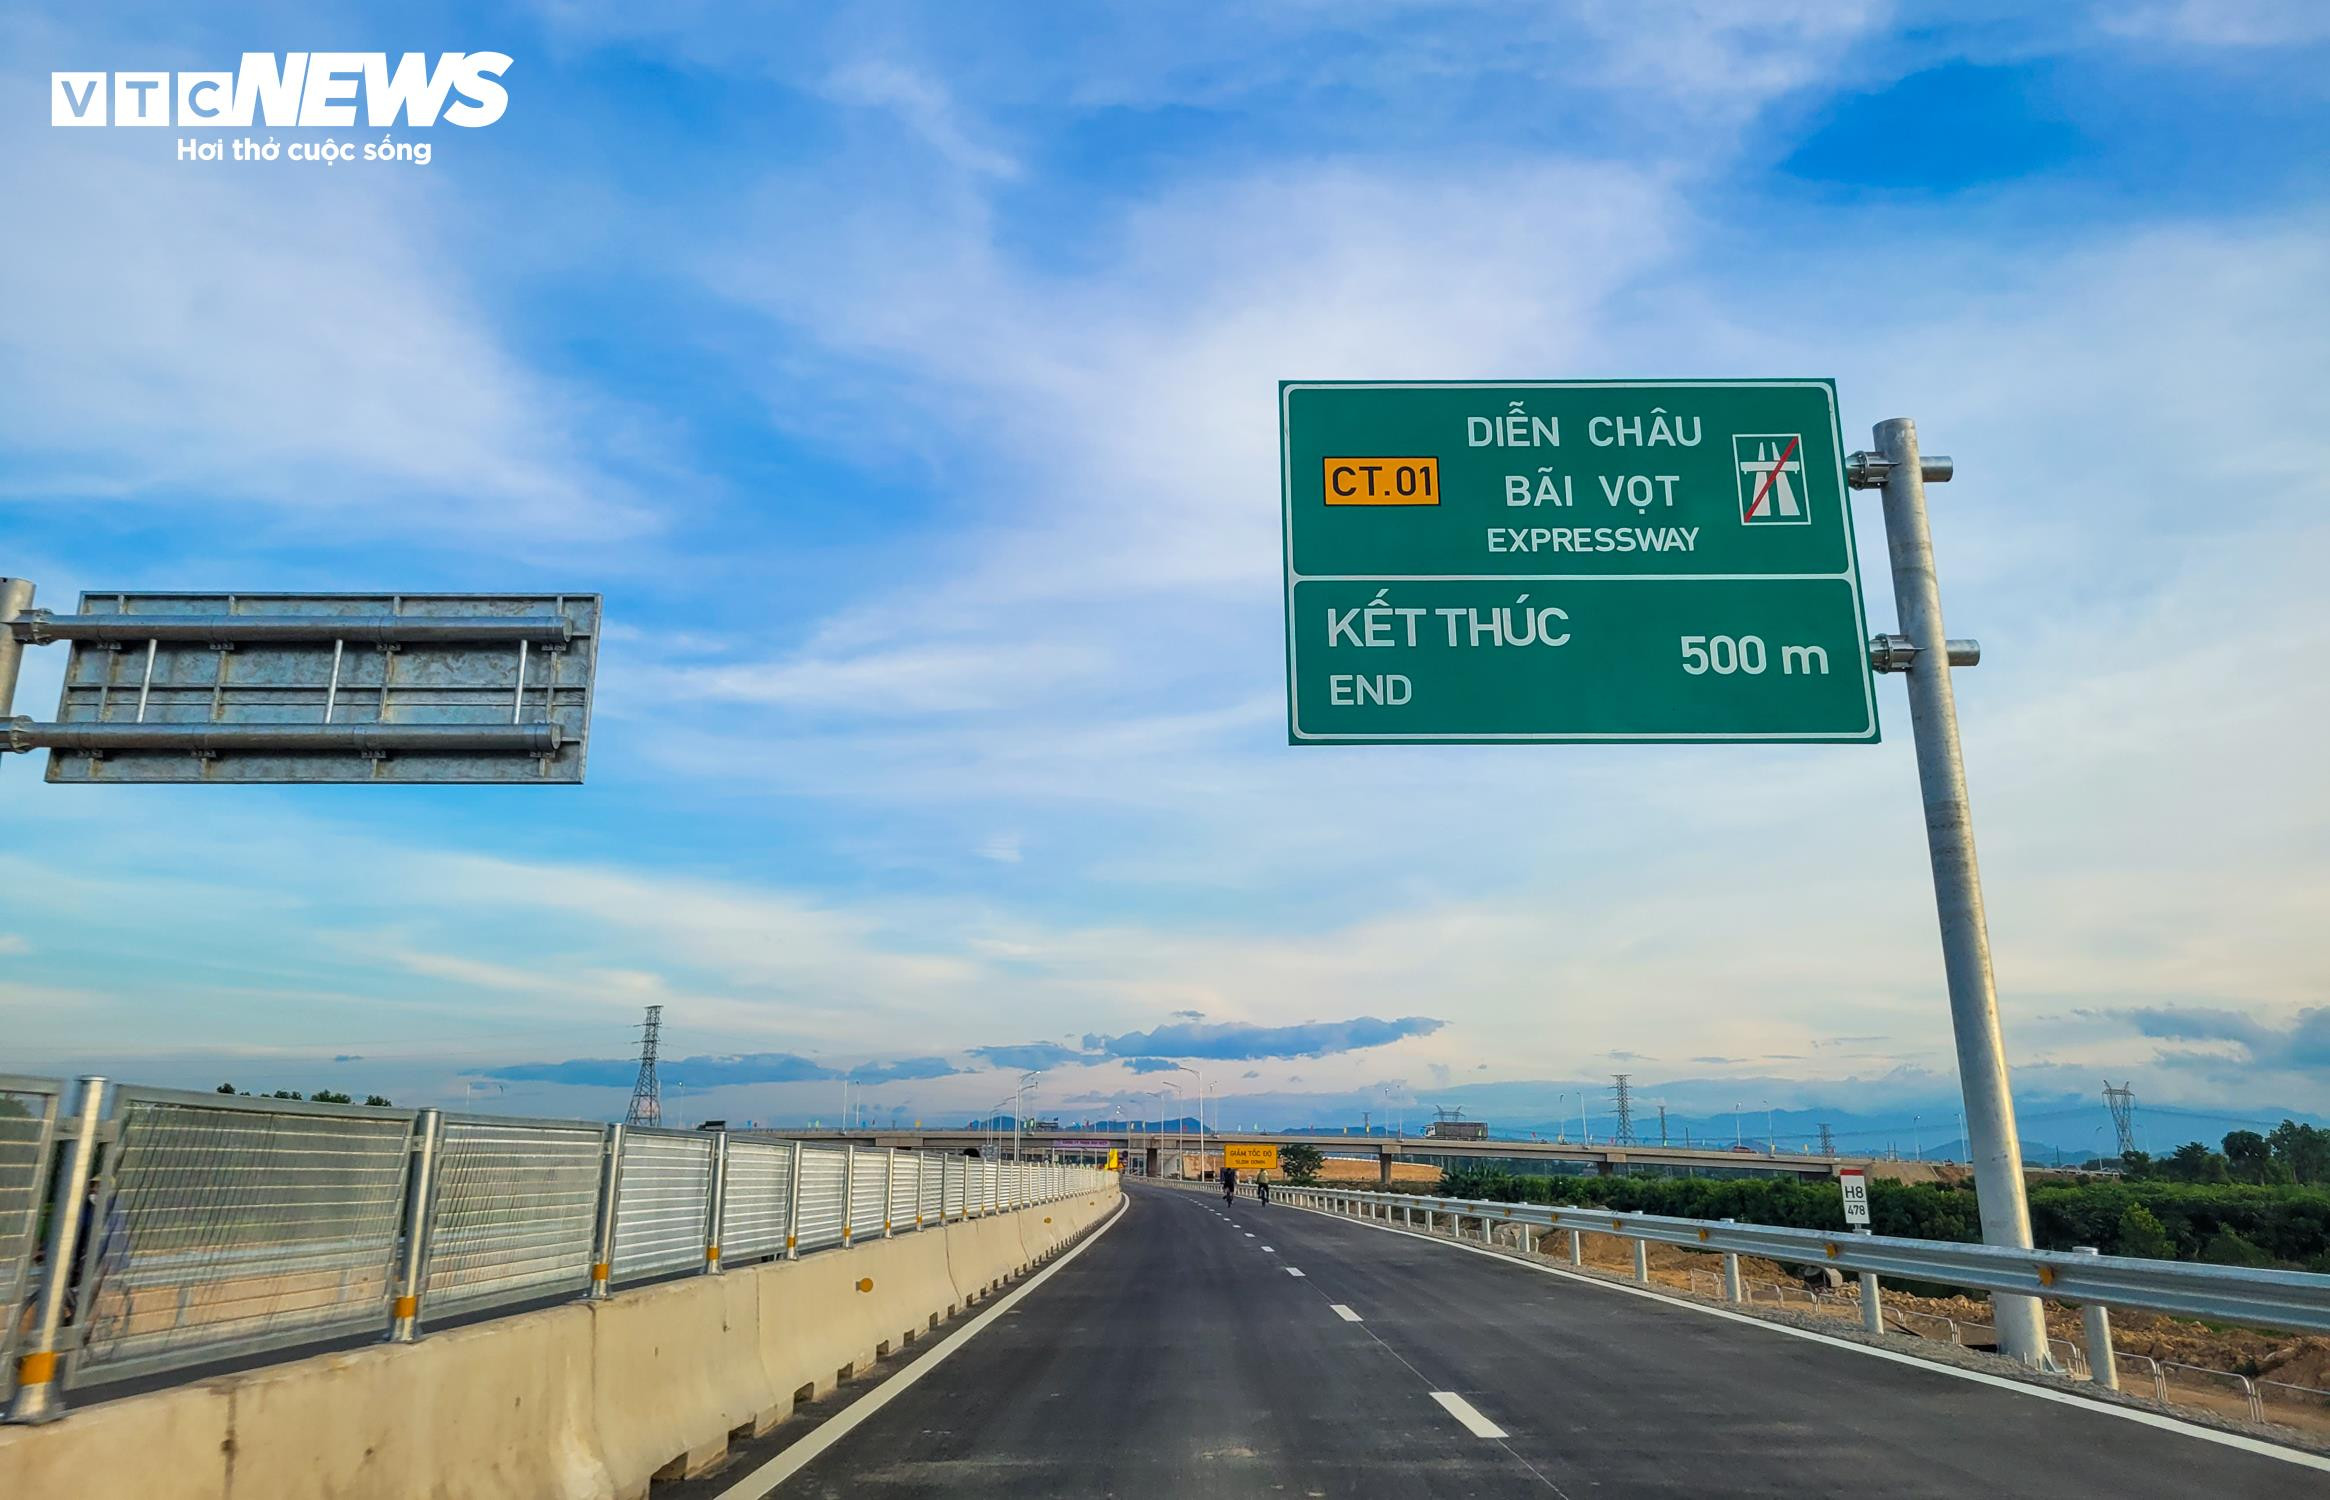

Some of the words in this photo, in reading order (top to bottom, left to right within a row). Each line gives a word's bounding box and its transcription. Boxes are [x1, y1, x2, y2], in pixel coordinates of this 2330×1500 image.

[1467, 401, 1560, 447] DIỄN
[1588, 407, 1702, 447] CHÂU
[1331, 465, 1432, 497] CT.01
[1505, 466, 1573, 507] BÃI
[1598, 475, 1680, 515] VỌT
[1487, 527, 1700, 552] EXPRESSWAY
[1327, 588, 1426, 647] KẾT
[1435, 594, 1571, 647] THÚC
[1680, 635, 1767, 675] 500
[1781, 645, 1829, 675] m
[1330, 674, 1412, 706] END
[1845, 1186, 1864, 1199] H8
[1848, 1205, 1866, 1216] 478
